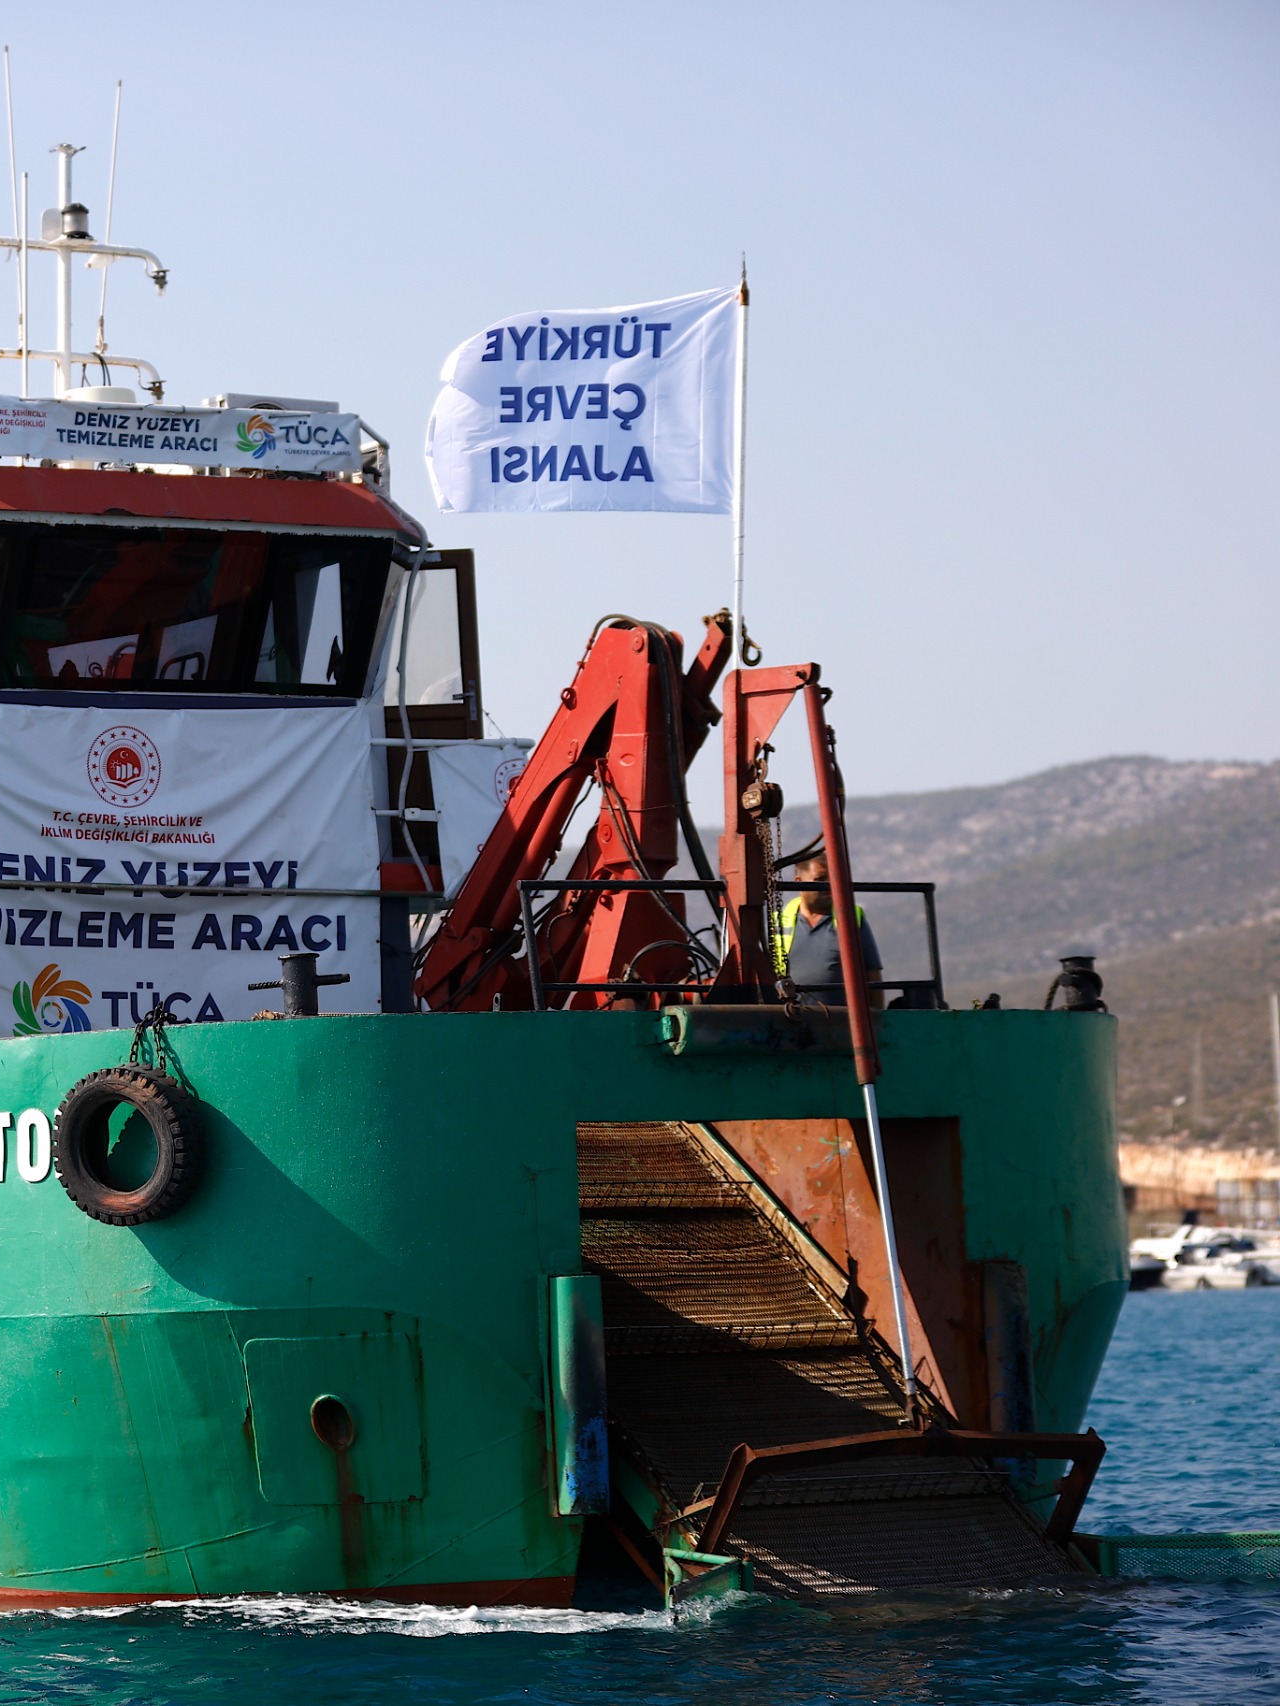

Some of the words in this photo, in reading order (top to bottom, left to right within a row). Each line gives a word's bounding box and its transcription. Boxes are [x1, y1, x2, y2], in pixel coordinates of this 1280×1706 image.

[74, 411, 131, 430] DENİZ
[136, 416, 200, 433] YÜZEYİ
[56, 428, 154, 449] TEMİZLEME
[160, 436, 218, 452] ARACI
[279, 420, 350, 448] TÜÇA
[53, 811, 74, 822] T.C.
[78, 812, 121, 826] ÇEVRE,
[123, 814, 187, 828] ŞEHİRCİLİK
[189, 816, 203, 827] VE
[41, 824, 73, 839] İKLİM
[151, 831, 216, 844] BAKANLIĞI
[191, 914, 346, 952] ARACI
